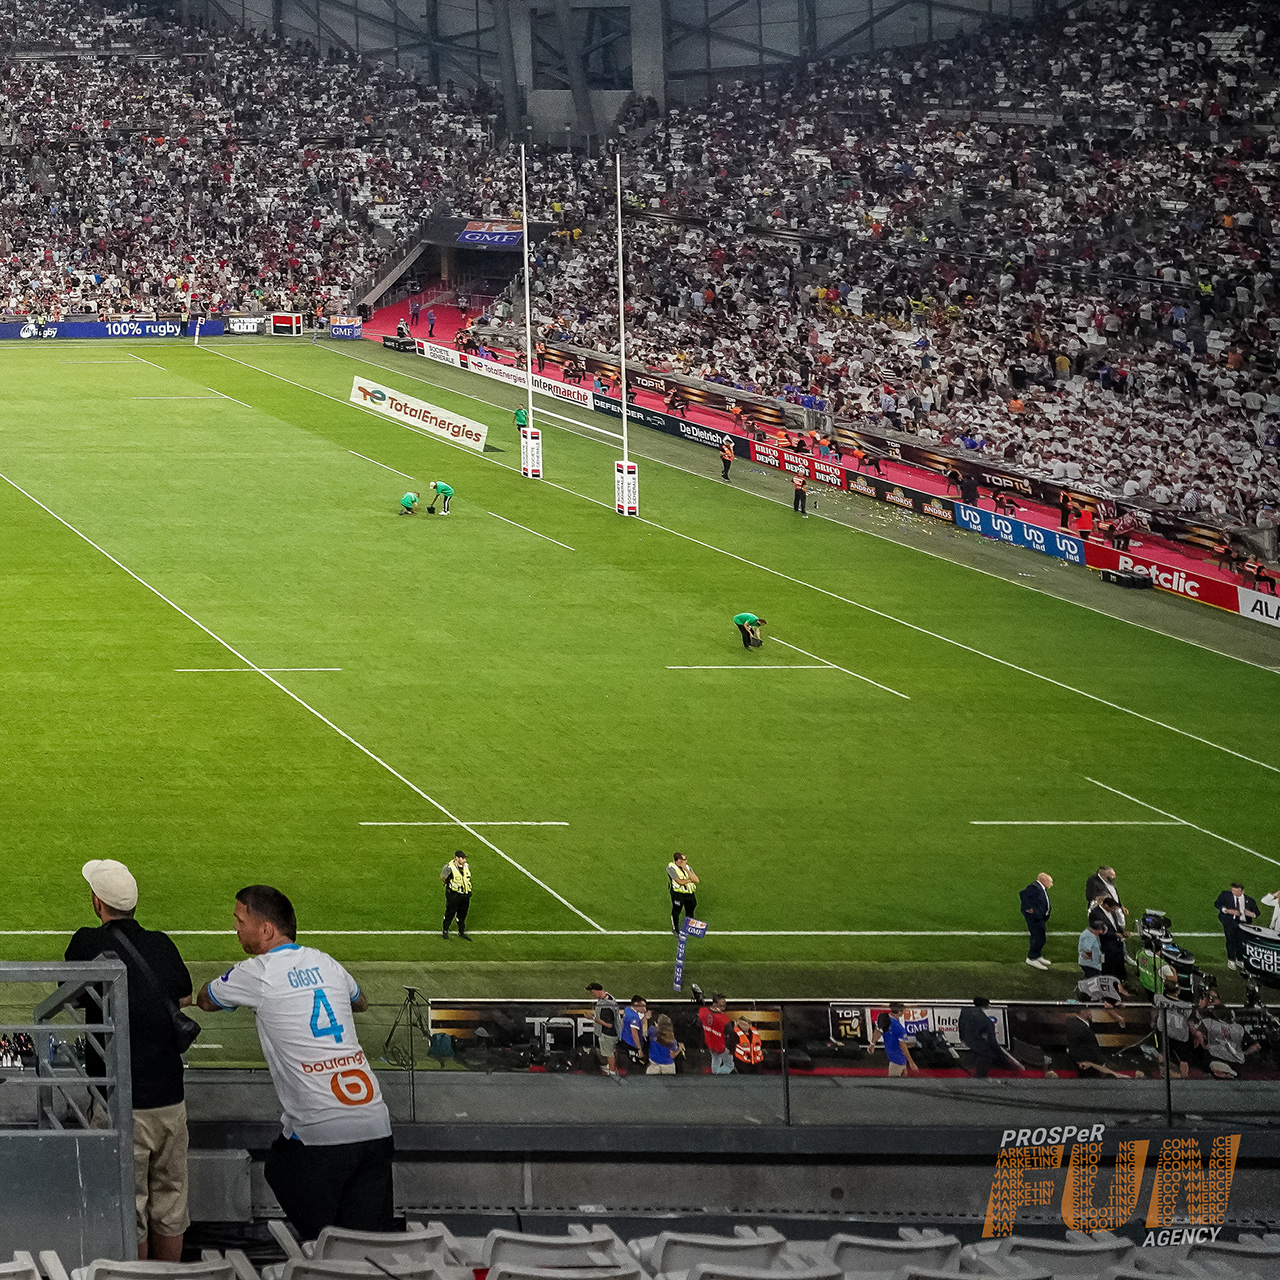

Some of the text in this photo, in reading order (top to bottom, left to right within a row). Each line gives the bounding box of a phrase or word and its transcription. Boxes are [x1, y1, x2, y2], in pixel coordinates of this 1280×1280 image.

[465, 233, 516, 242] GMF
[106, 322, 181, 337] 100% rugby
[332, 326, 353, 336] GMF
[484, 364, 526, 384] TotalEnergies
[532, 376, 589, 404] Intermarché
[636, 377, 666, 392] TOP14
[594, 398, 645, 421] DEFENDER
[388, 395, 482, 444] TotalEnergies
[691, 426, 723, 444] Dietrich
[755, 443, 779, 458] BRICO
[886, 440, 901, 449] TOP
[756, 453, 780, 469] DEPÔT
[784, 453, 809, 467] BRICO
[814, 462, 841, 476] BRICO
[815, 472, 842, 488] DEPÔT
[982, 473, 1033, 496] TOP14
[849, 482, 877, 497] ANDROS
[886, 493, 913, 509] ANDROS
[923, 504, 953, 520] ANDROS
[1118, 554, 1200, 598] Betclic
[687, 926, 703, 937] GMF
[1246, 943, 1280, 965] Rugb
[309, 988, 344, 1044] 4
[836, 1010, 860, 1018] TOP
[937, 1015, 959, 1026] Inte
[906, 1023, 928, 1034] GMF
